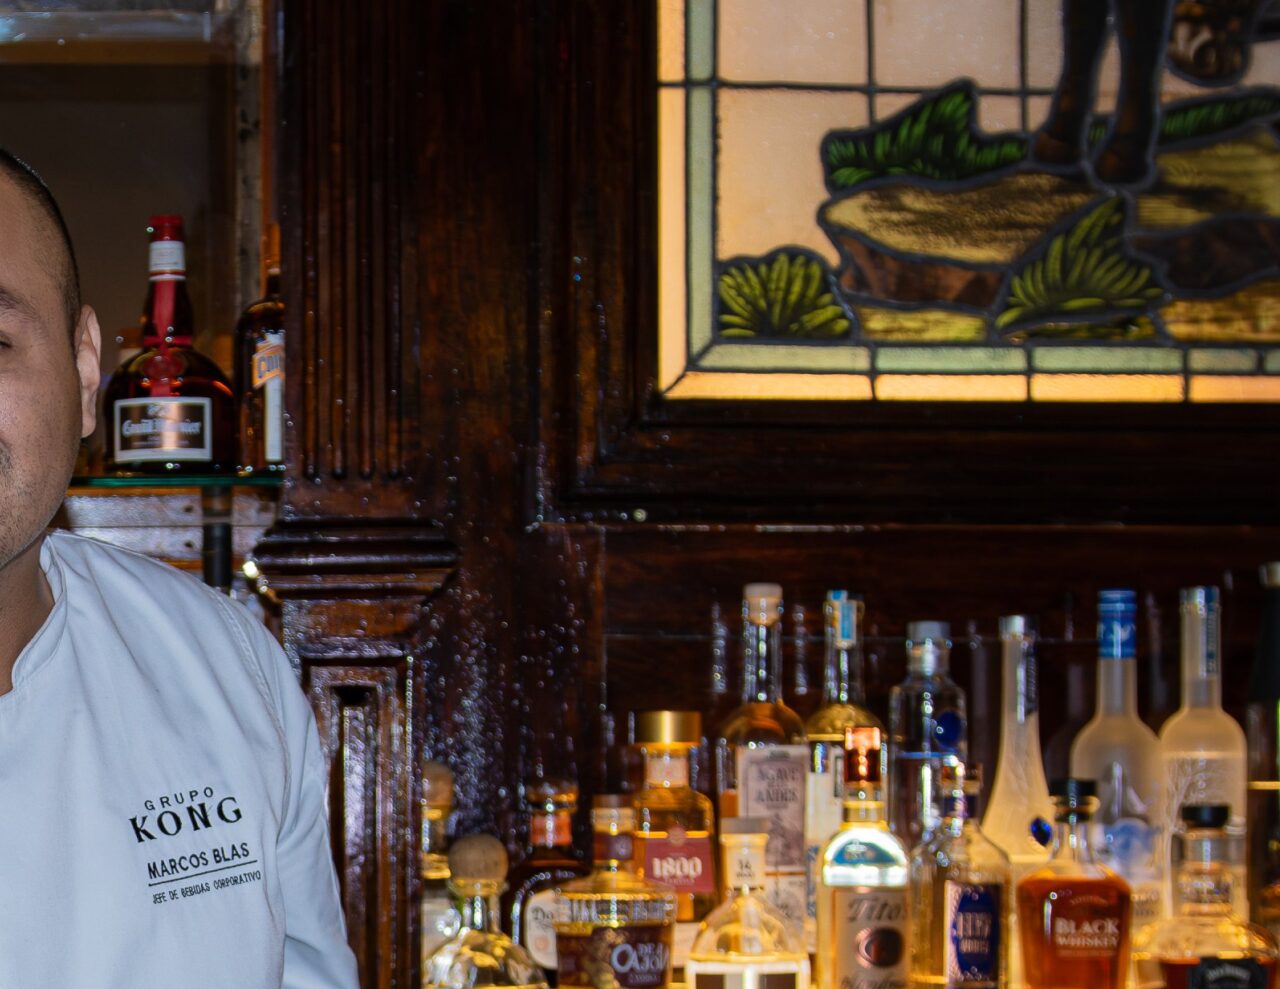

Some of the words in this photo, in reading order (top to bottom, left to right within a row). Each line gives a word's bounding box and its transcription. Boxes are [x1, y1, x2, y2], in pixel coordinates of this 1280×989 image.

[144, 786, 214, 811] GRUPO
[128, 796, 243, 843] KONG
[147, 851, 209, 880] MARCOS
[212, 842, 250, 864] BLAS
[652, 857, 703, 880] 1800
[152, 891, 168, 905] JEFE
[169, 889, 179, 902] DE
[181, 882, 211, 898] BEBIDAS
[213, 869, 262, 891] CORPORATIVO
[1055, 917, 1119, 934] BLACK
[1055, 935, 1119, 947] WHISKEY
